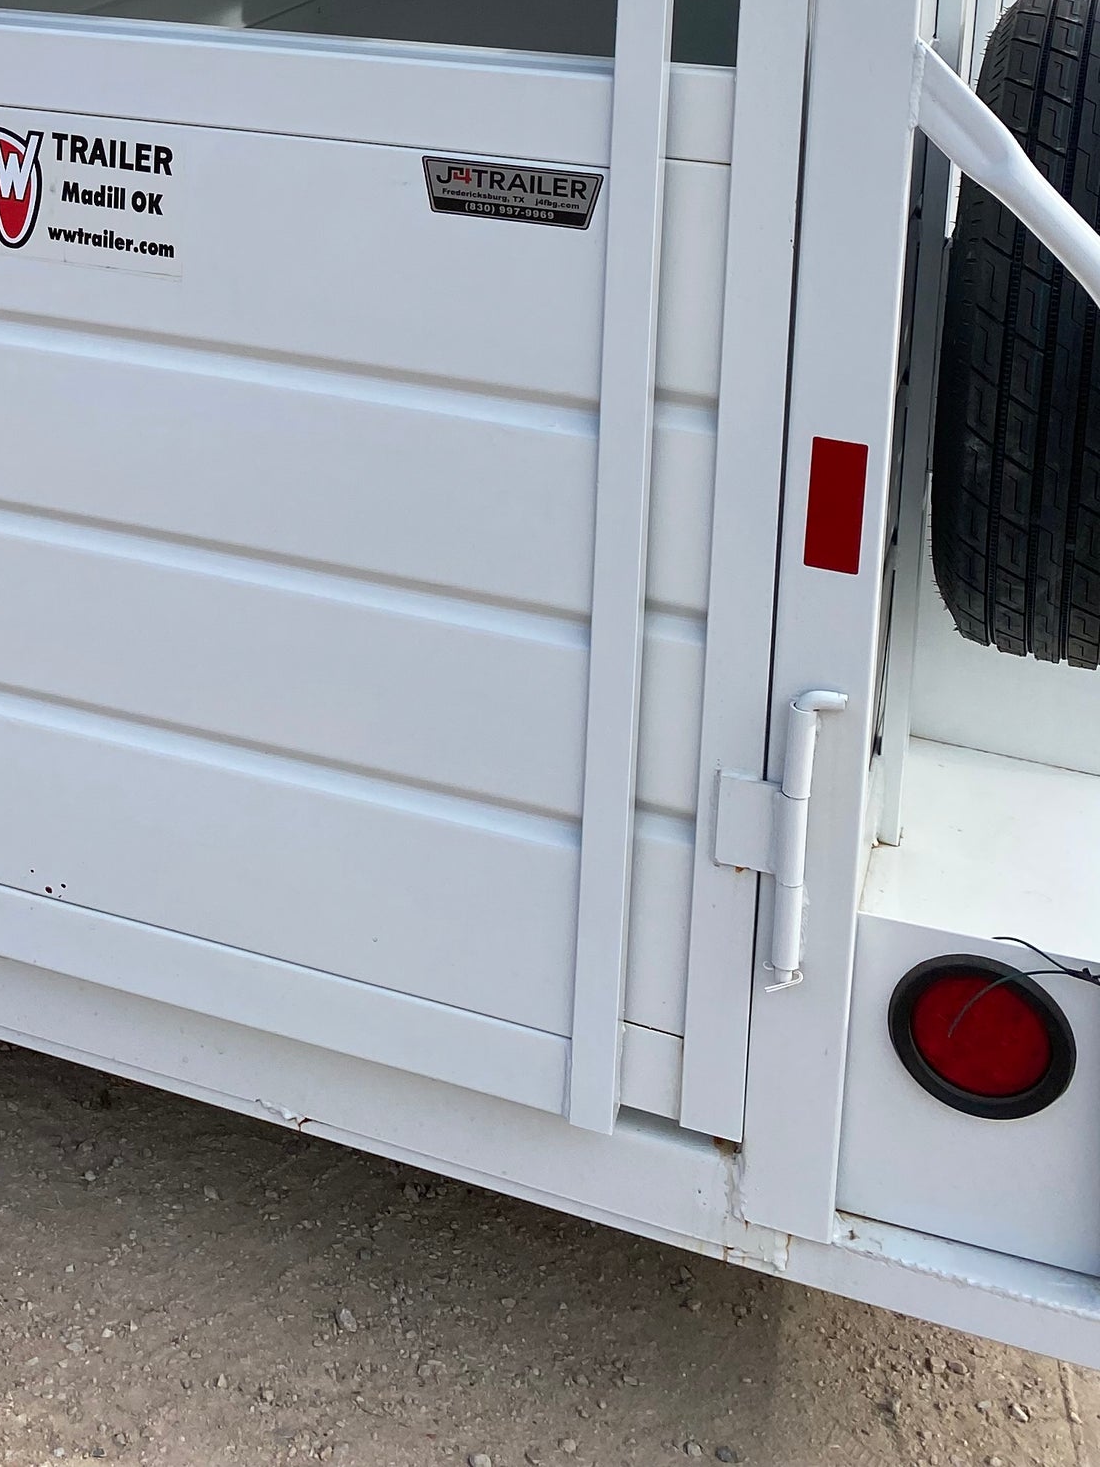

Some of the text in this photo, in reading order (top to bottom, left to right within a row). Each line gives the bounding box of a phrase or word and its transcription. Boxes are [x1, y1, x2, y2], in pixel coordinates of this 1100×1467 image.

[52, 131, 174, 177] TRAILER
[61, 180, 164, 216] Madill OK
[442, 187, 510, 203] Fredericksburg,
[512, 195, 525, 204] TX
[464, 202, 555, 220] (830) 997-9969
[48, 226, 175, 258] wwtrailer.com
